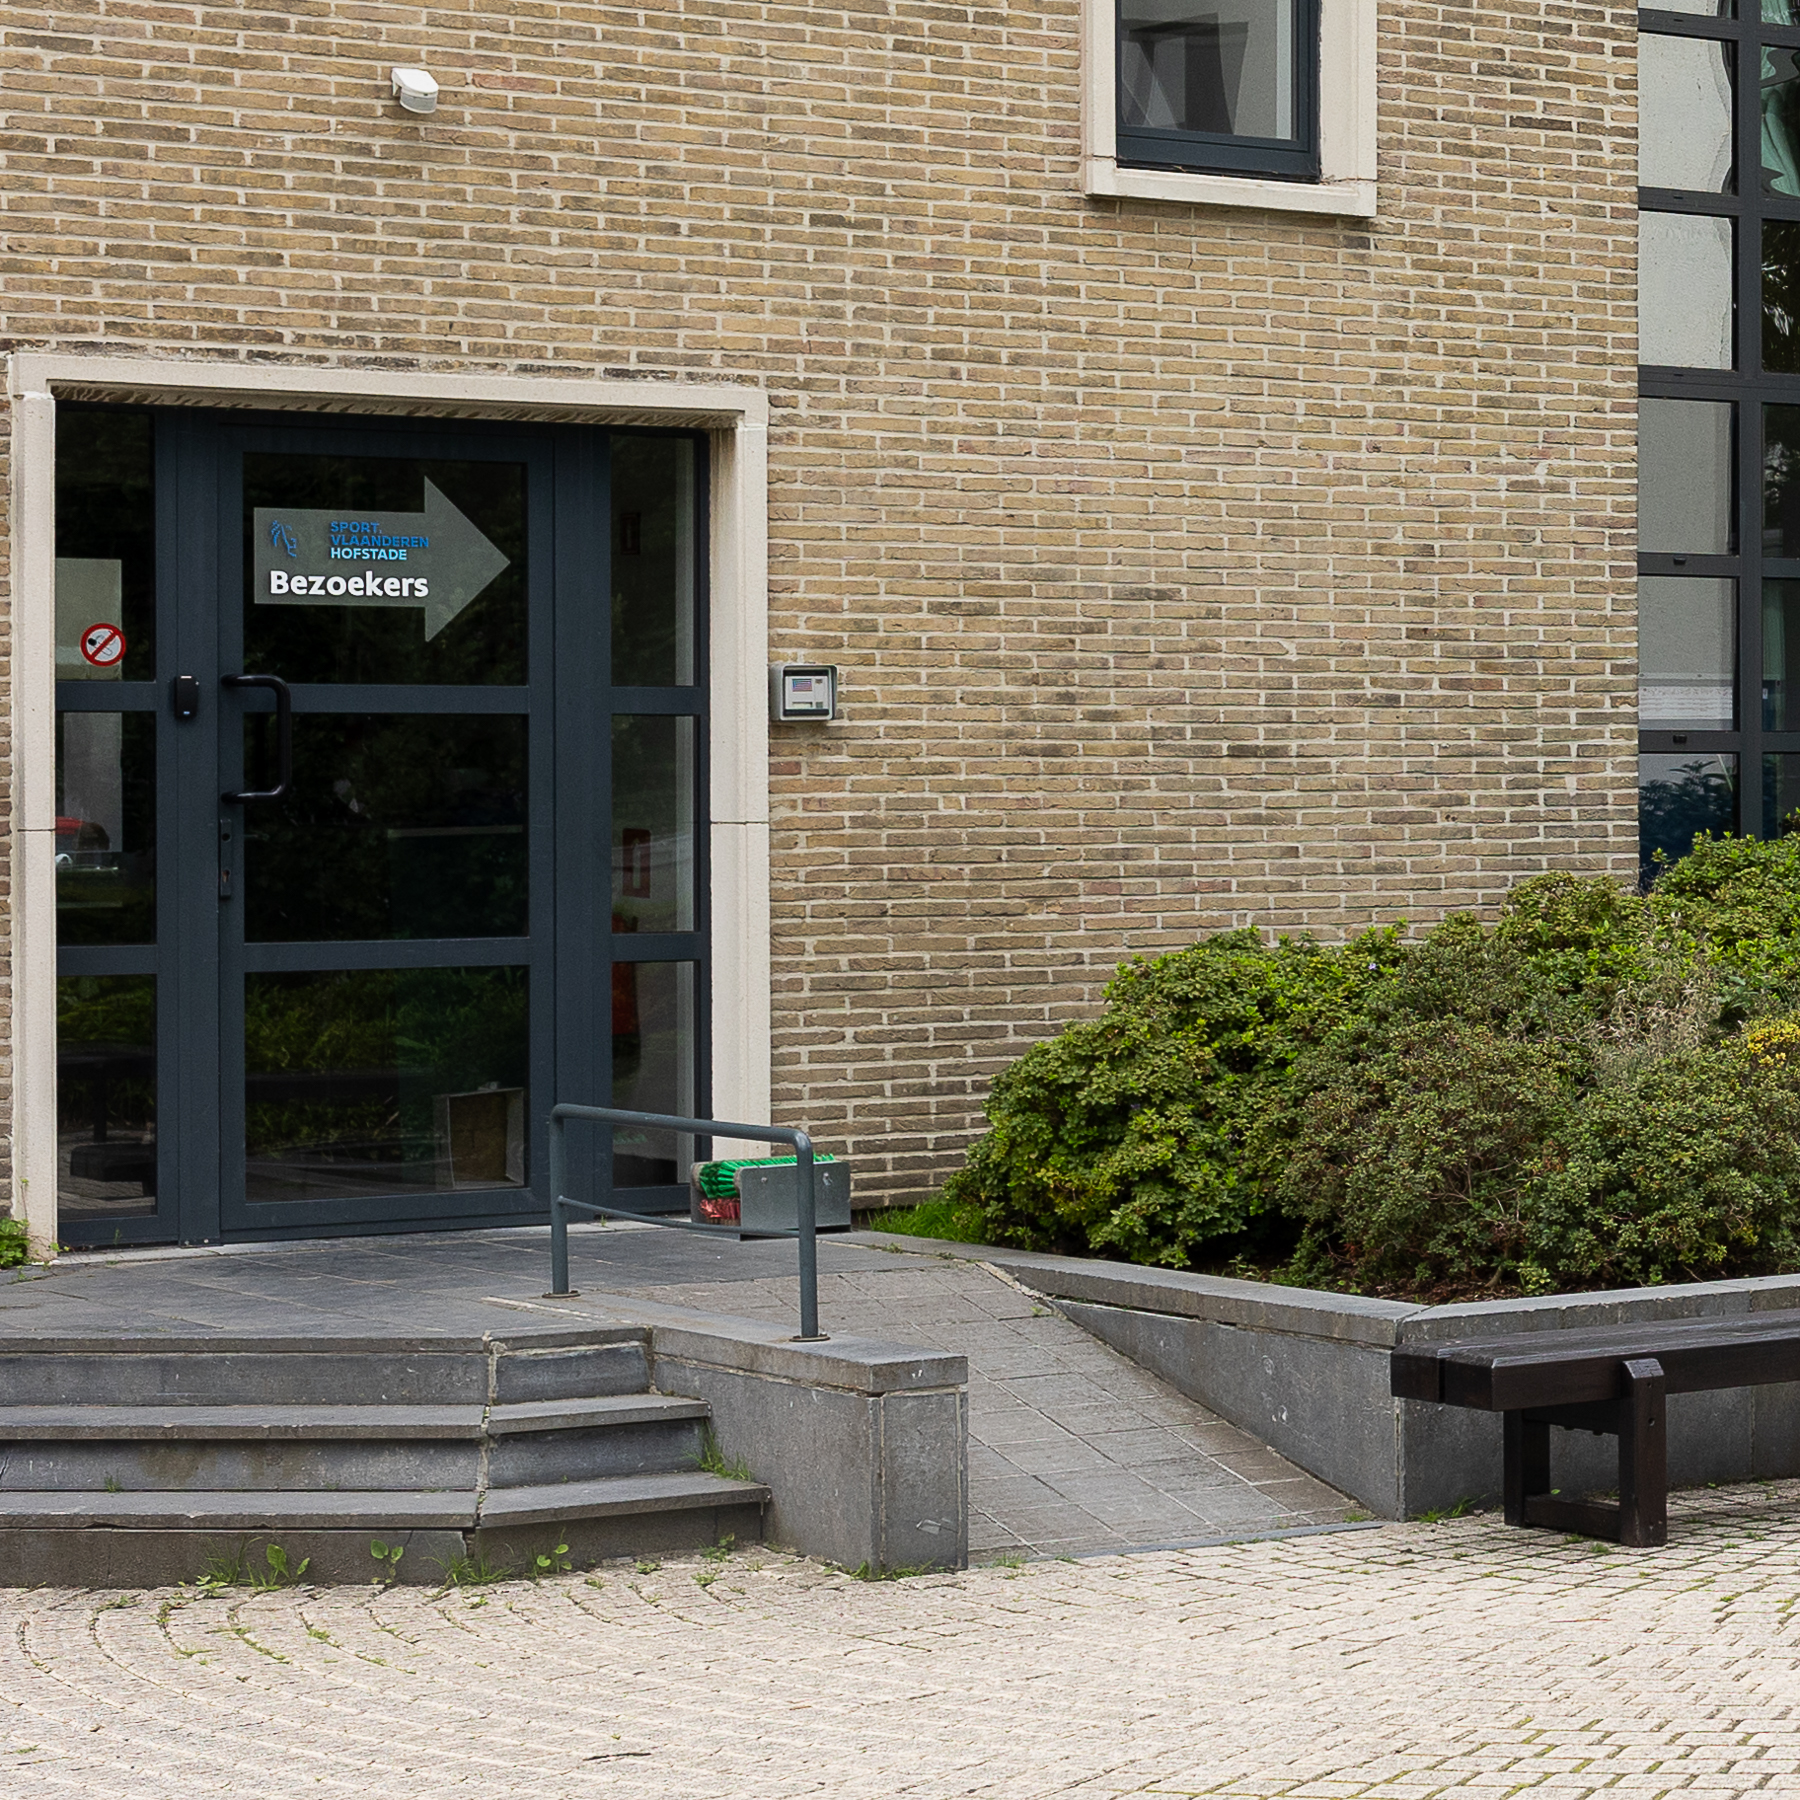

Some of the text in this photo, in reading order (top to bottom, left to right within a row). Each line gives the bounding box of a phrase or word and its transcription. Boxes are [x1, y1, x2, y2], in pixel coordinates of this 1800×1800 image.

[330, 535, 429, 548] VLAANDEREN
[330, 547, 407, 561] HOFSTADE
[269, 570, 429, 597] Bezoekers
